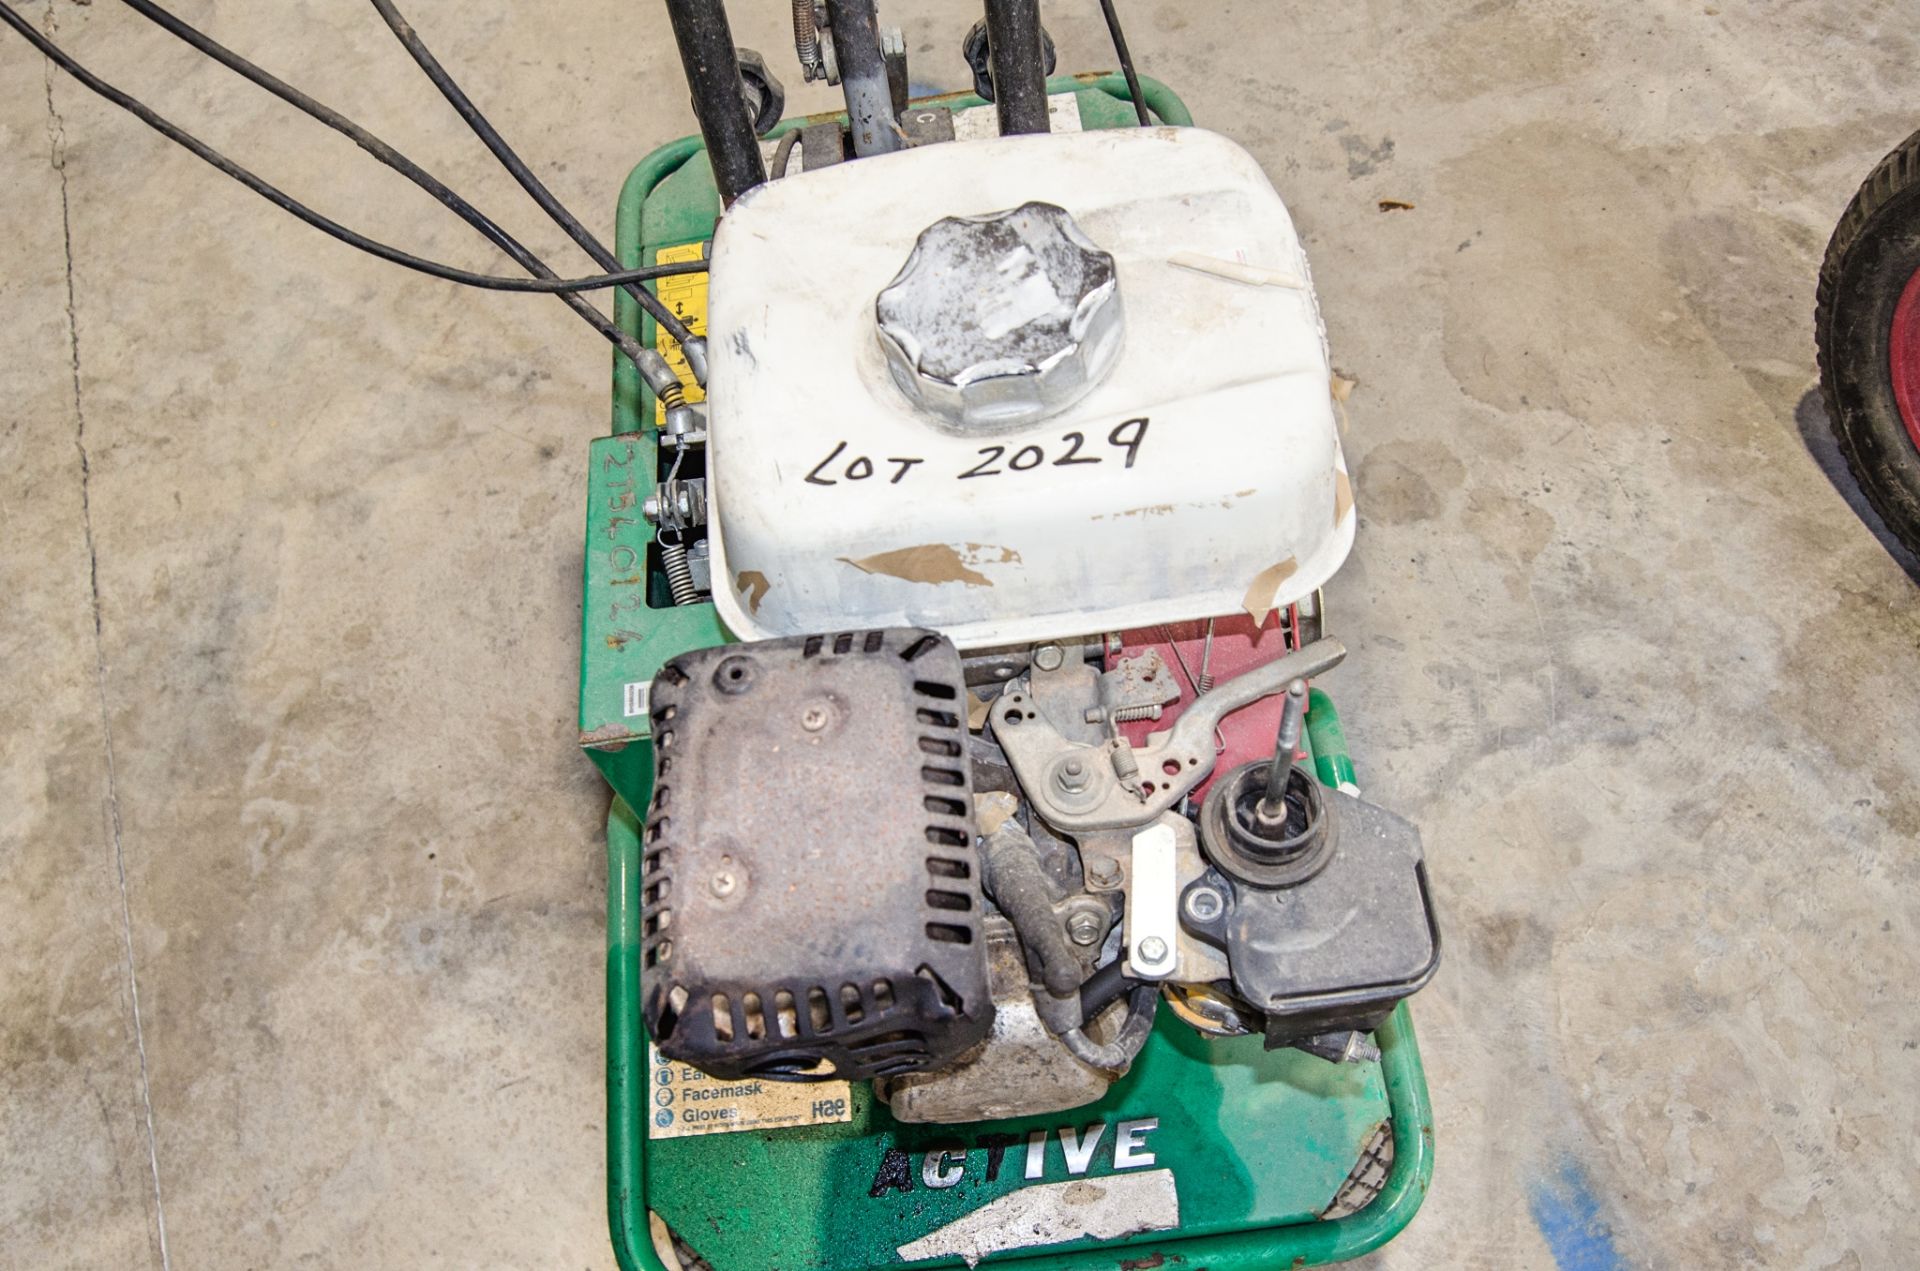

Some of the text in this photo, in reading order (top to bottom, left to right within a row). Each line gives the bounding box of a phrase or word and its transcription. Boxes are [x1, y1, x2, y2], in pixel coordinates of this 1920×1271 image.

[804, 417, 1150, 485] LOT 2029
[682, 1080, 763, 1102] Facemask
[682, 1107, 738, 1124] Gloves
[868, 1117, 1159, 1197] ACTIVE
